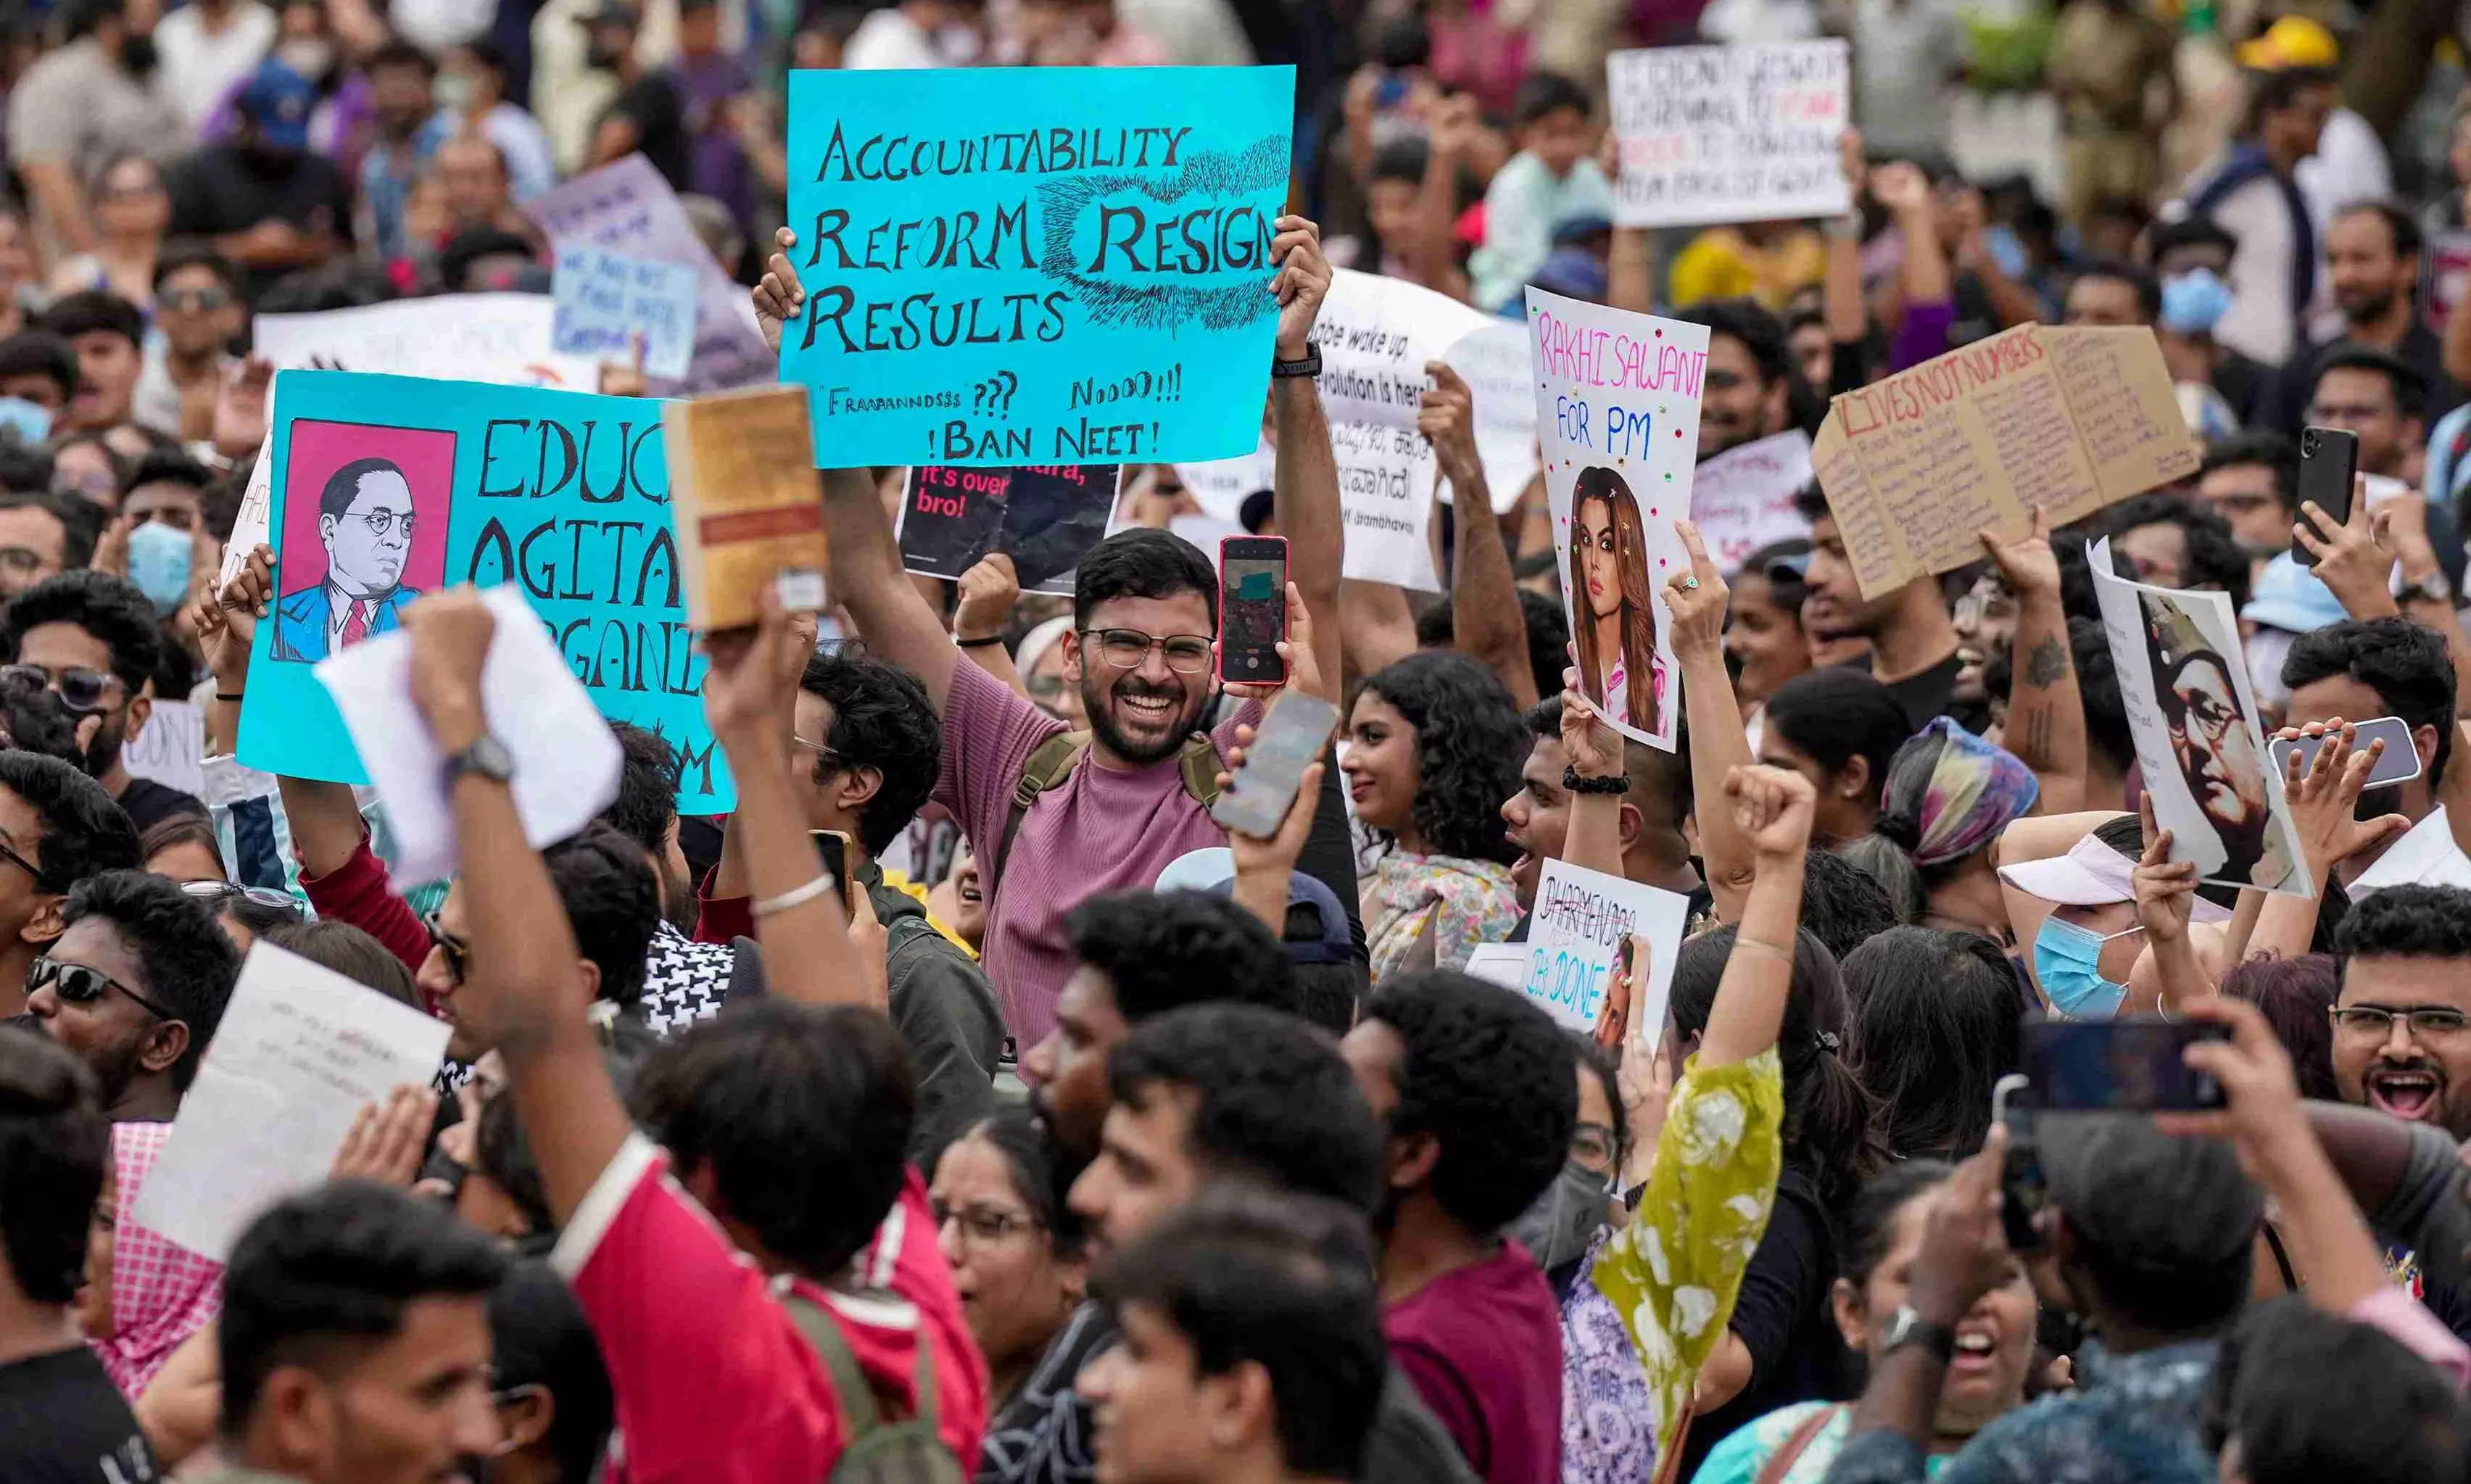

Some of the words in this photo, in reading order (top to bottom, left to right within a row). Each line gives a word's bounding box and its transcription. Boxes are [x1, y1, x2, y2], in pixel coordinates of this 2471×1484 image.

[813, 117, 1193, 182] ACCOUNTABILITY
[805, 196, 1039, 274] REFORM
[1086, 202, 1283, 273] RESIGN
[800, 285, 1078, 352] RESULTS
[1538, 310, 1610, 386] RAKHI
[478, 418, 673, 507] EDUC
[1557, 395, 1593, 448] FOR
[1607, 406, 1651, 461] PM
[916, 487, 967, 520] bro!
[963, 472, 1010, 496] over
[467, 515, 682, 608] AGITA
[1549, 950, 1606, 1019] DONE
